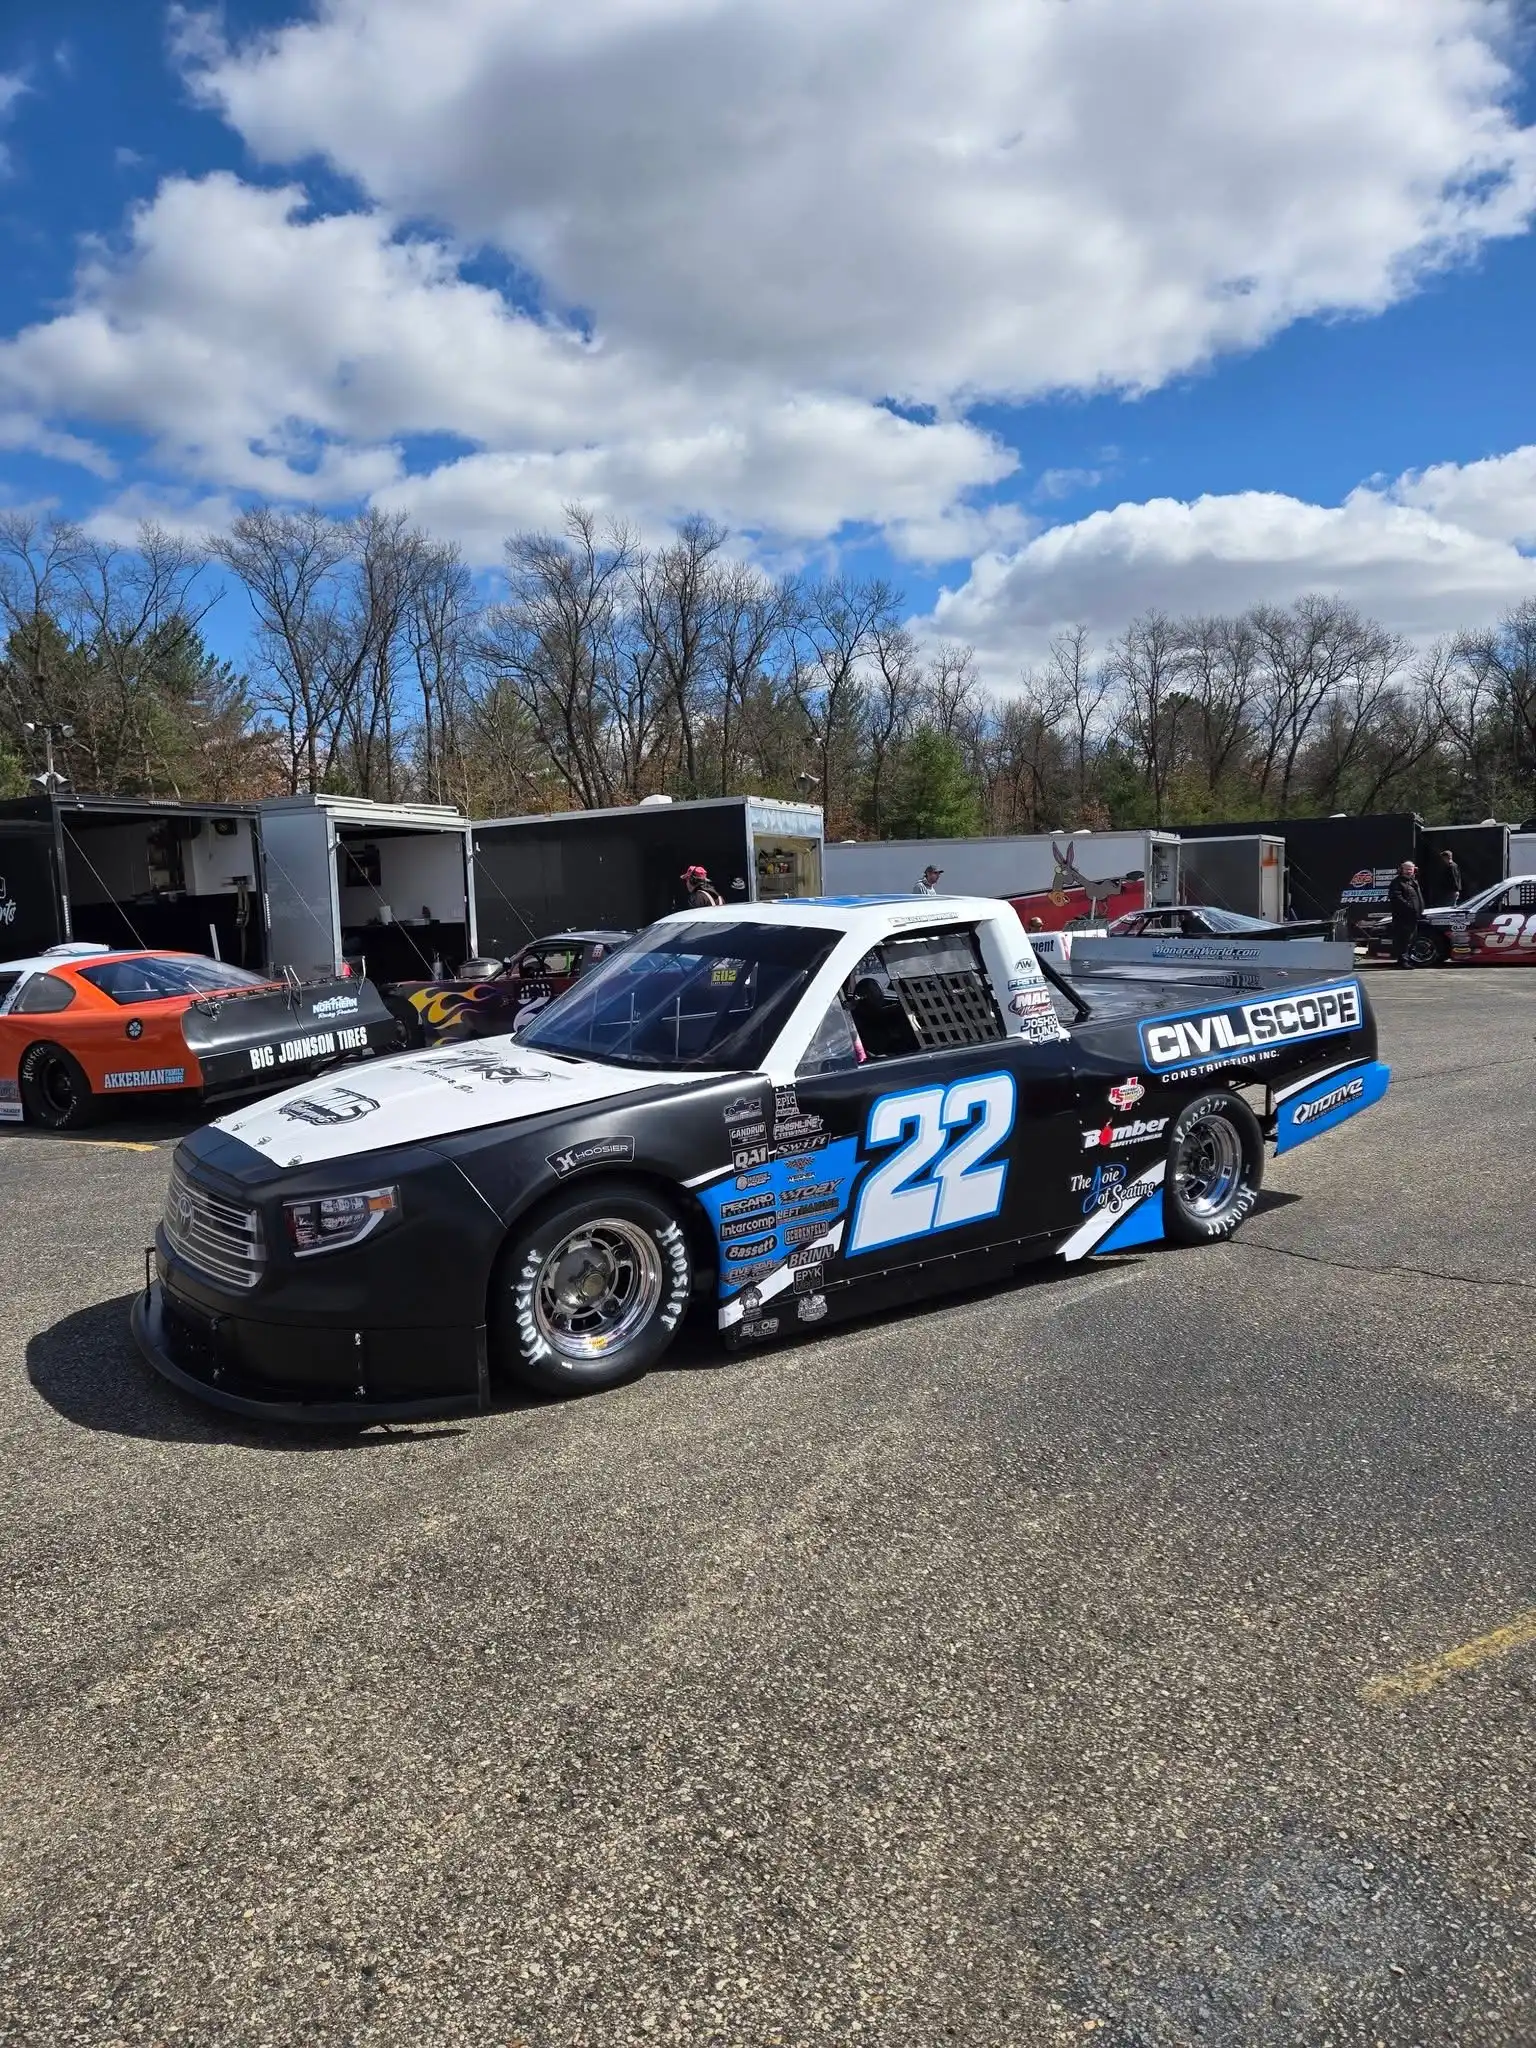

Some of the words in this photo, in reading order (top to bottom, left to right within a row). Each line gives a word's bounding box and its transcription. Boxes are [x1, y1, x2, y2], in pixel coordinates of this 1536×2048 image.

[313, 997, 358, 1014] NORTHERN
[1015, 990, 1051, 1009] MAC
[1147, 1013, 1249, 1063] CIVIL
[1249, 990, 1357, 1039] SCOPE
[250, 1046, 275, 1070] BIG
[279, 1033, 335, 1064] JOHNSON
[337, 1026, 368, 1051] TIRES
[1162, 1053, 1256, 1083] CONSTRUCTION
[1259, 1049, 1280, 1060] INC.
[104, 1069, 165, 1088] AKKERMAN
[731, 1124, 765, 1139] GANDRUD
[575, 1144, 629, 1160] HOOSIER
[735, 1147, 767, 1169] QA1
[846, 1070, 1016, 1258] 22
[1071, 1174, 1092, 1192] The
[722, 1193, 774, 1214] PECARO
[1098, 1188, 1111, 1208] of
[1109, 1180, 1156, 1213] Seating
[1207, 1181, 1258, 1236] Hoosier
[722, 1215, 775, 1237] Intercomp
[729, 1237, 774, 1258] Bassett
[789, 1245, 833, 1268] BRINN
[656, 1220, 689, 1331] Hoosier
[796, 1267, 822, 1282] EPYK
[511, 1249, 552, 1366] Hoosier
